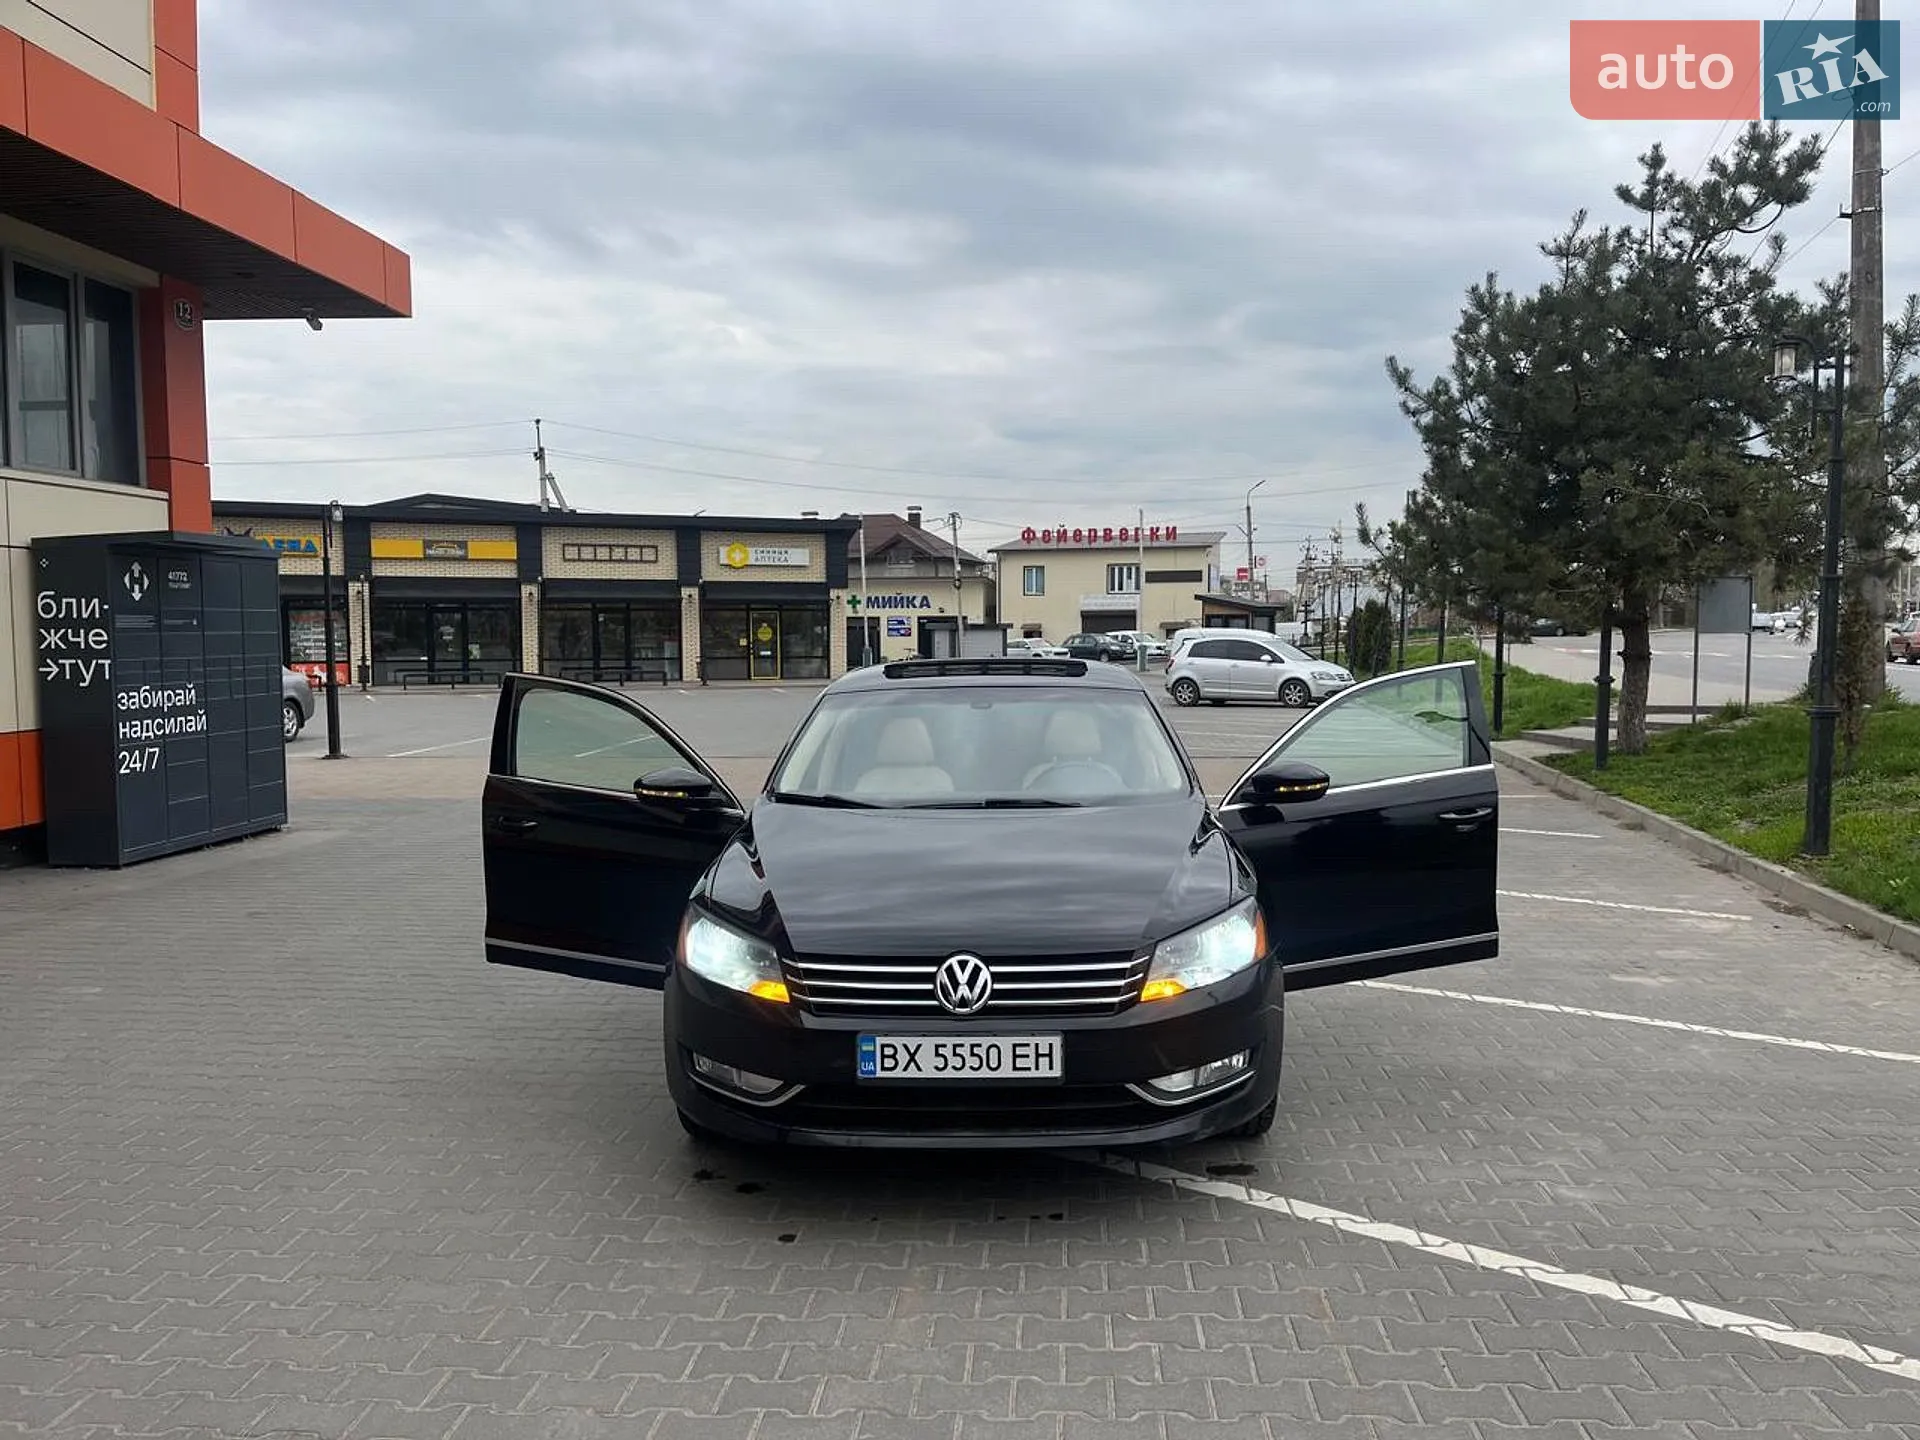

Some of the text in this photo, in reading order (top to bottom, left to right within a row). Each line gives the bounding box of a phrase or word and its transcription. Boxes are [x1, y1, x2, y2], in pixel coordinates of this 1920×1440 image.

[866, 592, 931, 609] МИЙКА
[39, 628, 108, 649] жче
[58, 659, 111, 687] тут
[117, 683, 196, 712] забирай
[119, 709, 208, 740] надсилай
[119, 747, 160, 774] 24/7
[861, 1042, 1054, 1072] UA BX 5550 EH
